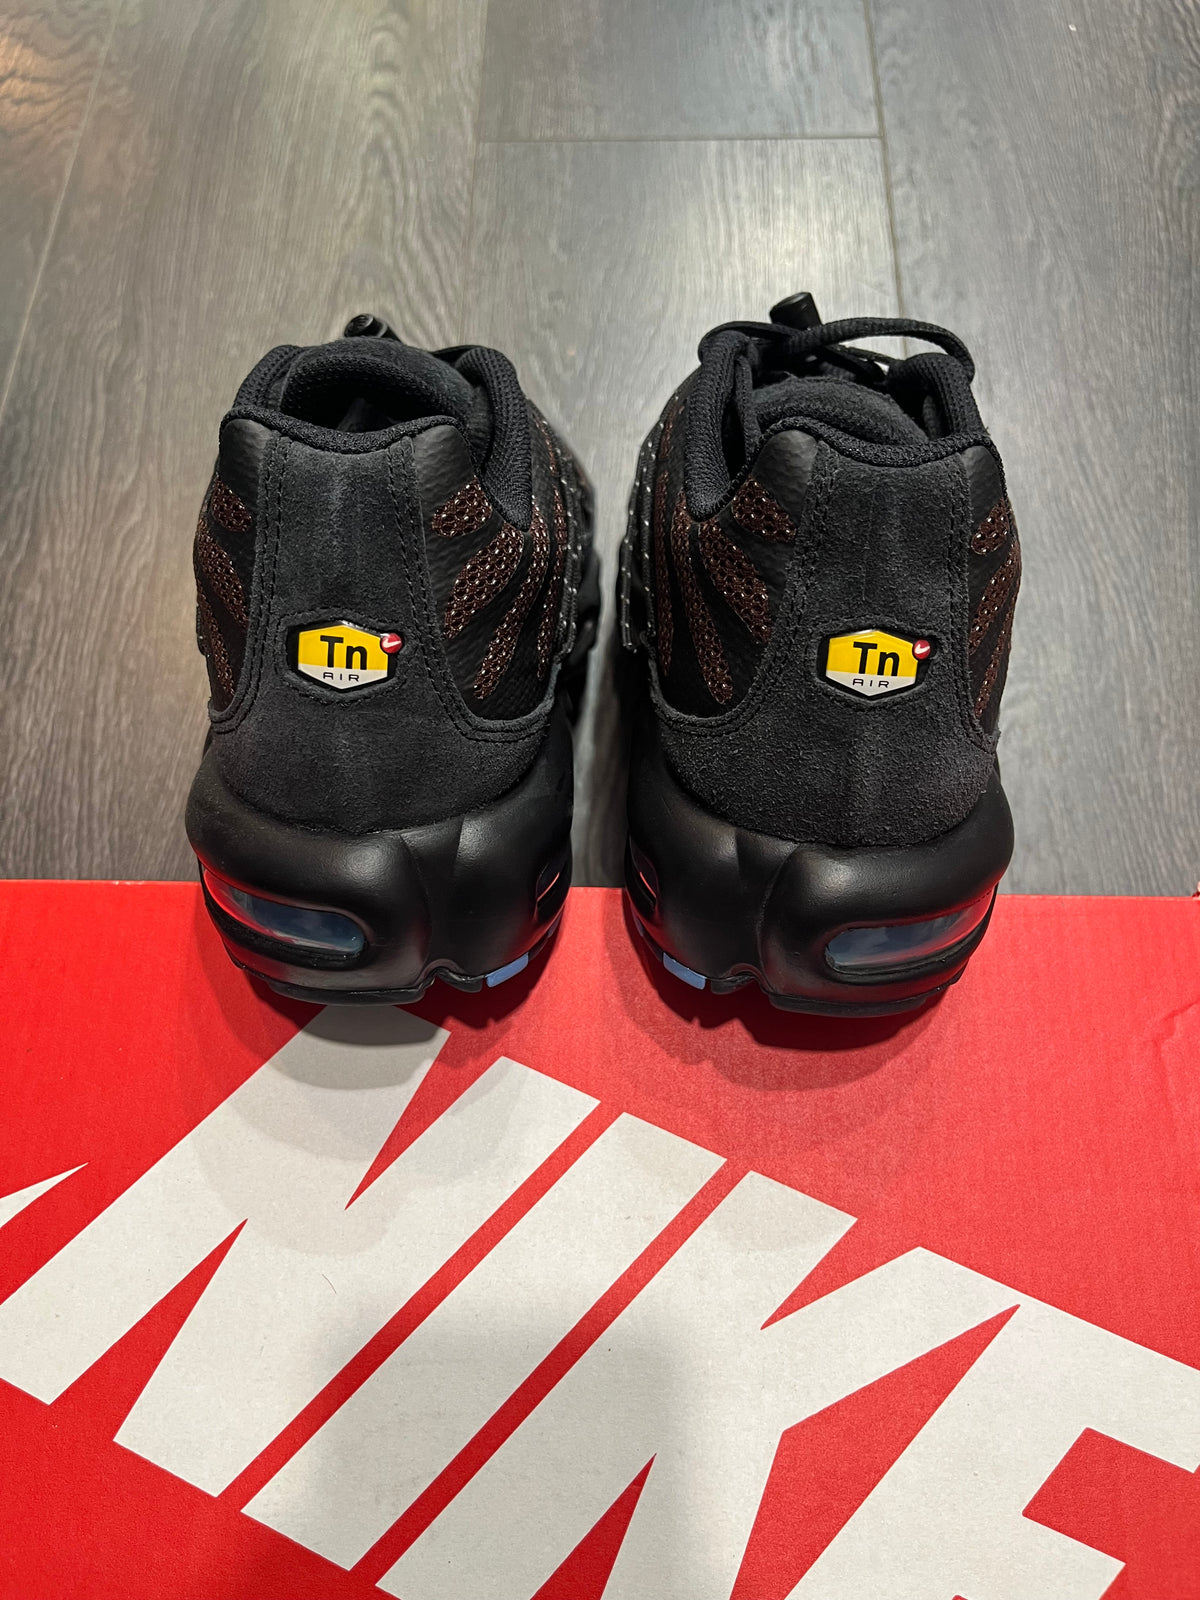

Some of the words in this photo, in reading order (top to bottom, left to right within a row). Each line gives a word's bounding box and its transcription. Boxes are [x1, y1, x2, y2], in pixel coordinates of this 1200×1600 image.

[320, 635, 367, 670] Tn
[853, 641, 900, 677] Tn
[323, 672, 360, 682] AIR
[852, 678, 890, 688] AIR
